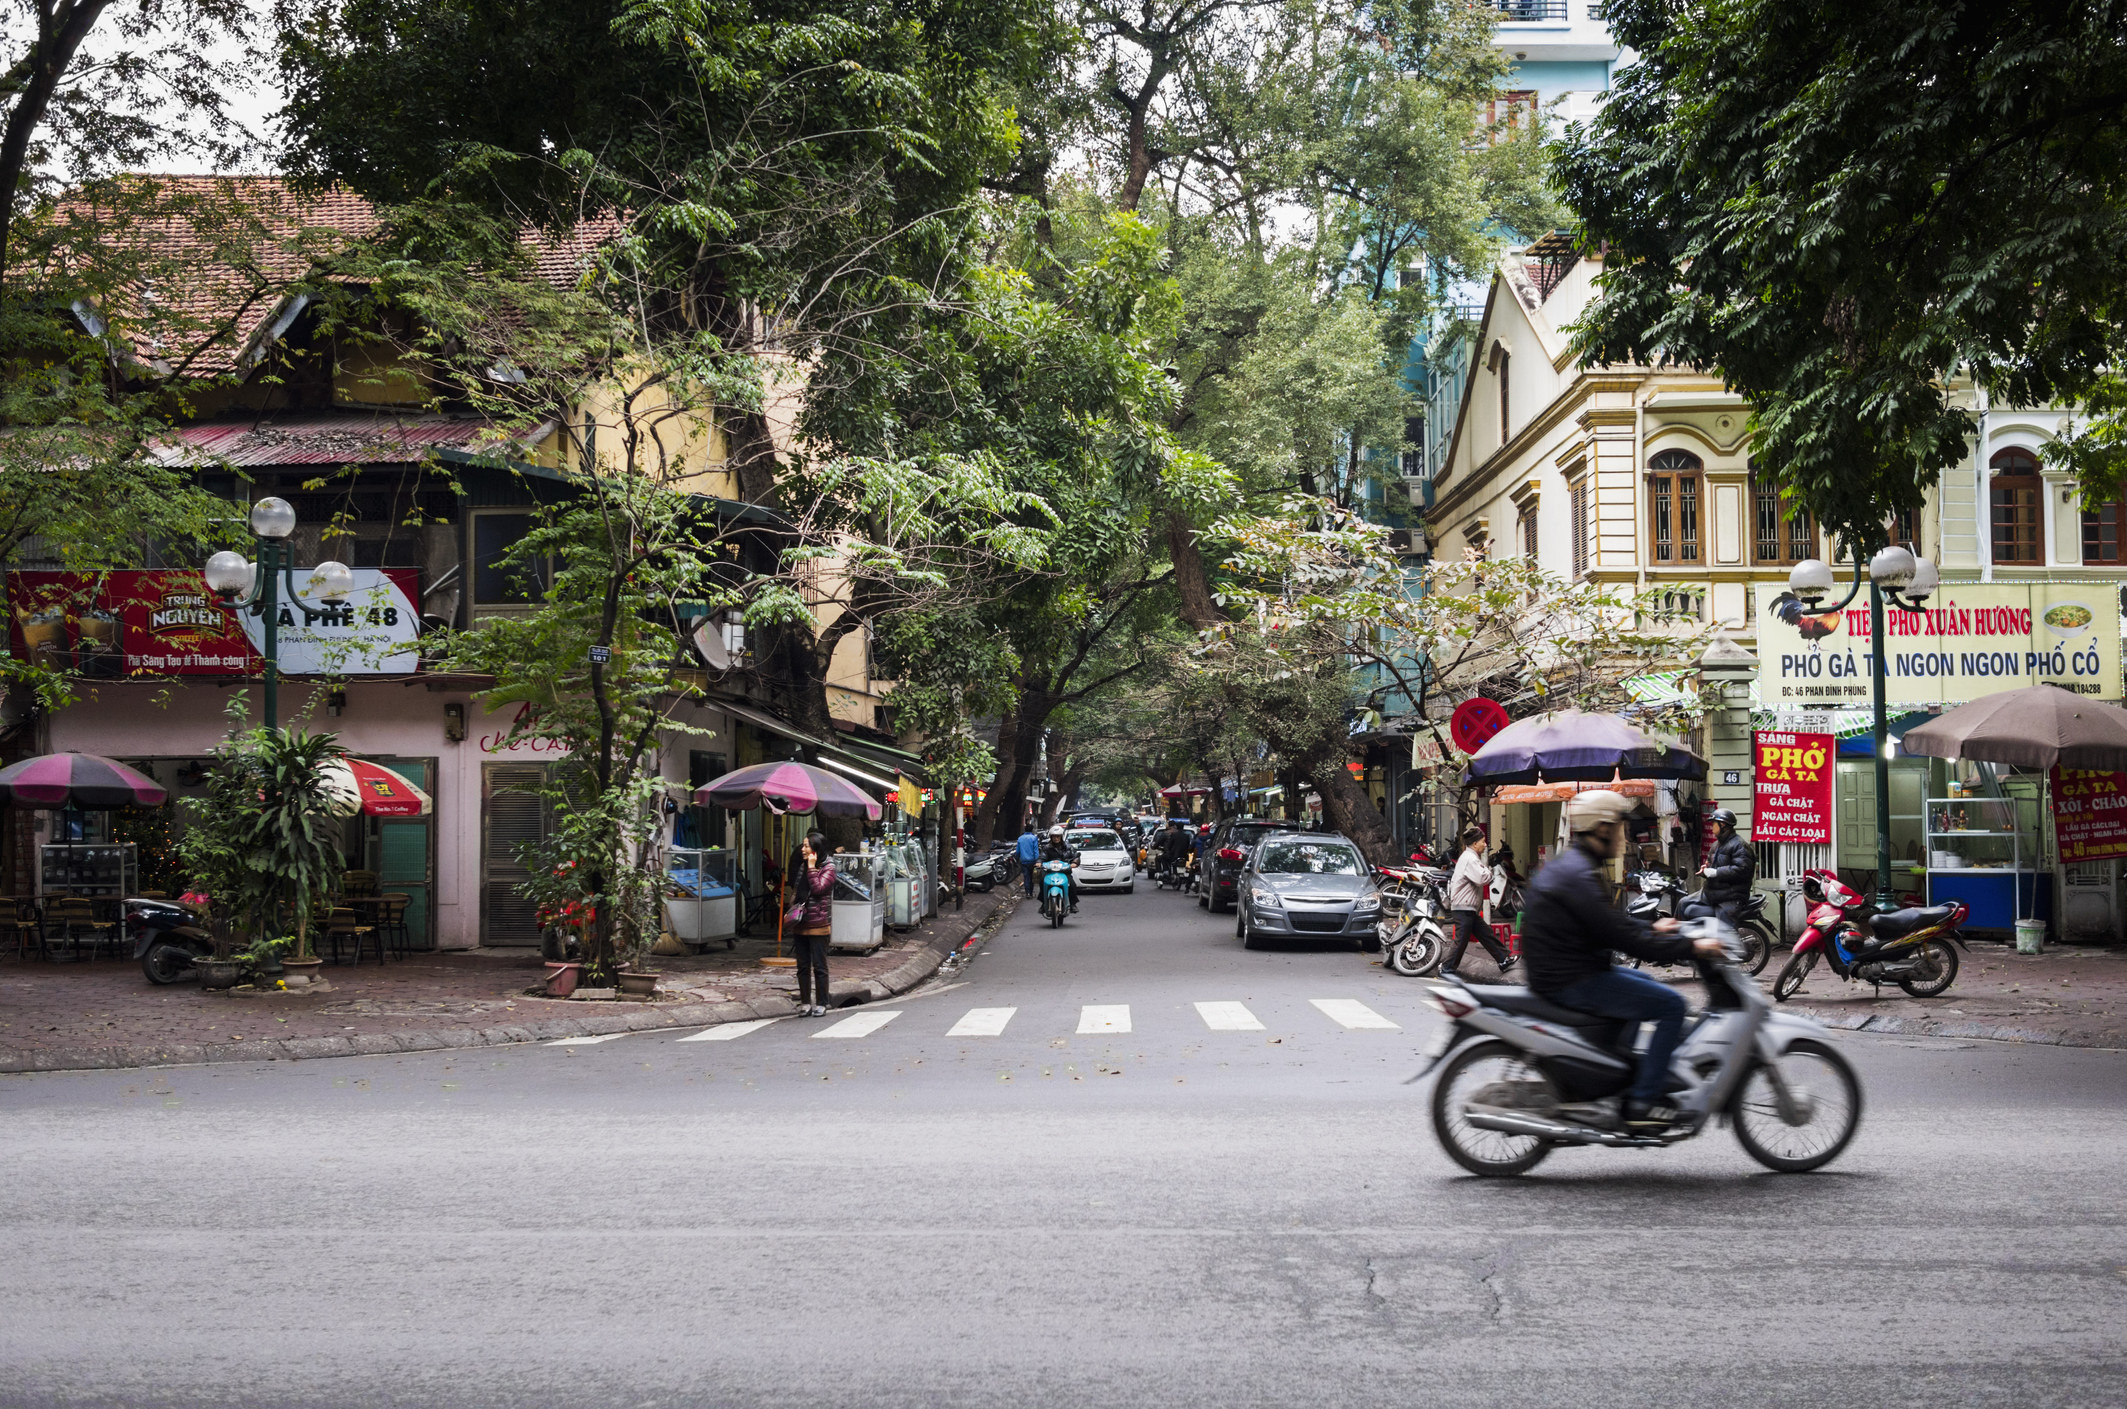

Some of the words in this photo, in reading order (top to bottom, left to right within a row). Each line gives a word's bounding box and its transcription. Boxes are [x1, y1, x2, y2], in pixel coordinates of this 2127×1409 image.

[365, 607, 398, 627] 48
[1846, 600, 1872, 644] TIỆ
[1925, 600, 1970, 636] XUÂN
[1974, 605, 2032, 636] HƯƠNG
[193, 654, 221, 667] Thành
[222, 655, 244, 669] công
[1781, 644, 1822, 678] PHỞ
[1828, 648, 1857, 677] GÀ
[1896, 652, 1954, 677] NGON
[1961, 652, 2019, 677] NGON
[2025, 640, 2066, 676] PHỐ
[2072, 637, 2100, 676] CỔ
[1782, 686, 1794, 697] ĐC:
[1795, 686, 1804, 697] 46
[1805, 686, 1824, 697] PHAN
[1758, 732, 1796, 744] SÁNG
[1761, 742, 1826, 769] PHỞ
[1726, 773, 1738, 782] 46
[1766, 768, 1791, 780] GÀ
[1795, 771, 1819, 781] TA
[1756, 782, 1791, 794] TRƯA
[2062, 781, 2090, 796] GÀ
[2092, 781, 2118, 793] TA
[1769, 796, 1784, 807] GÀ
[1786, 797, 1814, 809] CHẶT
[2058, 797, 2082, 813] XÔI
[2092, 793, 2127, 810] CHÁO
[1761, 811, 1791, 821] NGAN
[1793, 812, 1821, 824] CHẶT
[1779, 825, 1799, 836] CÁC
[1801, 828, 1825, 839] LOẠI
